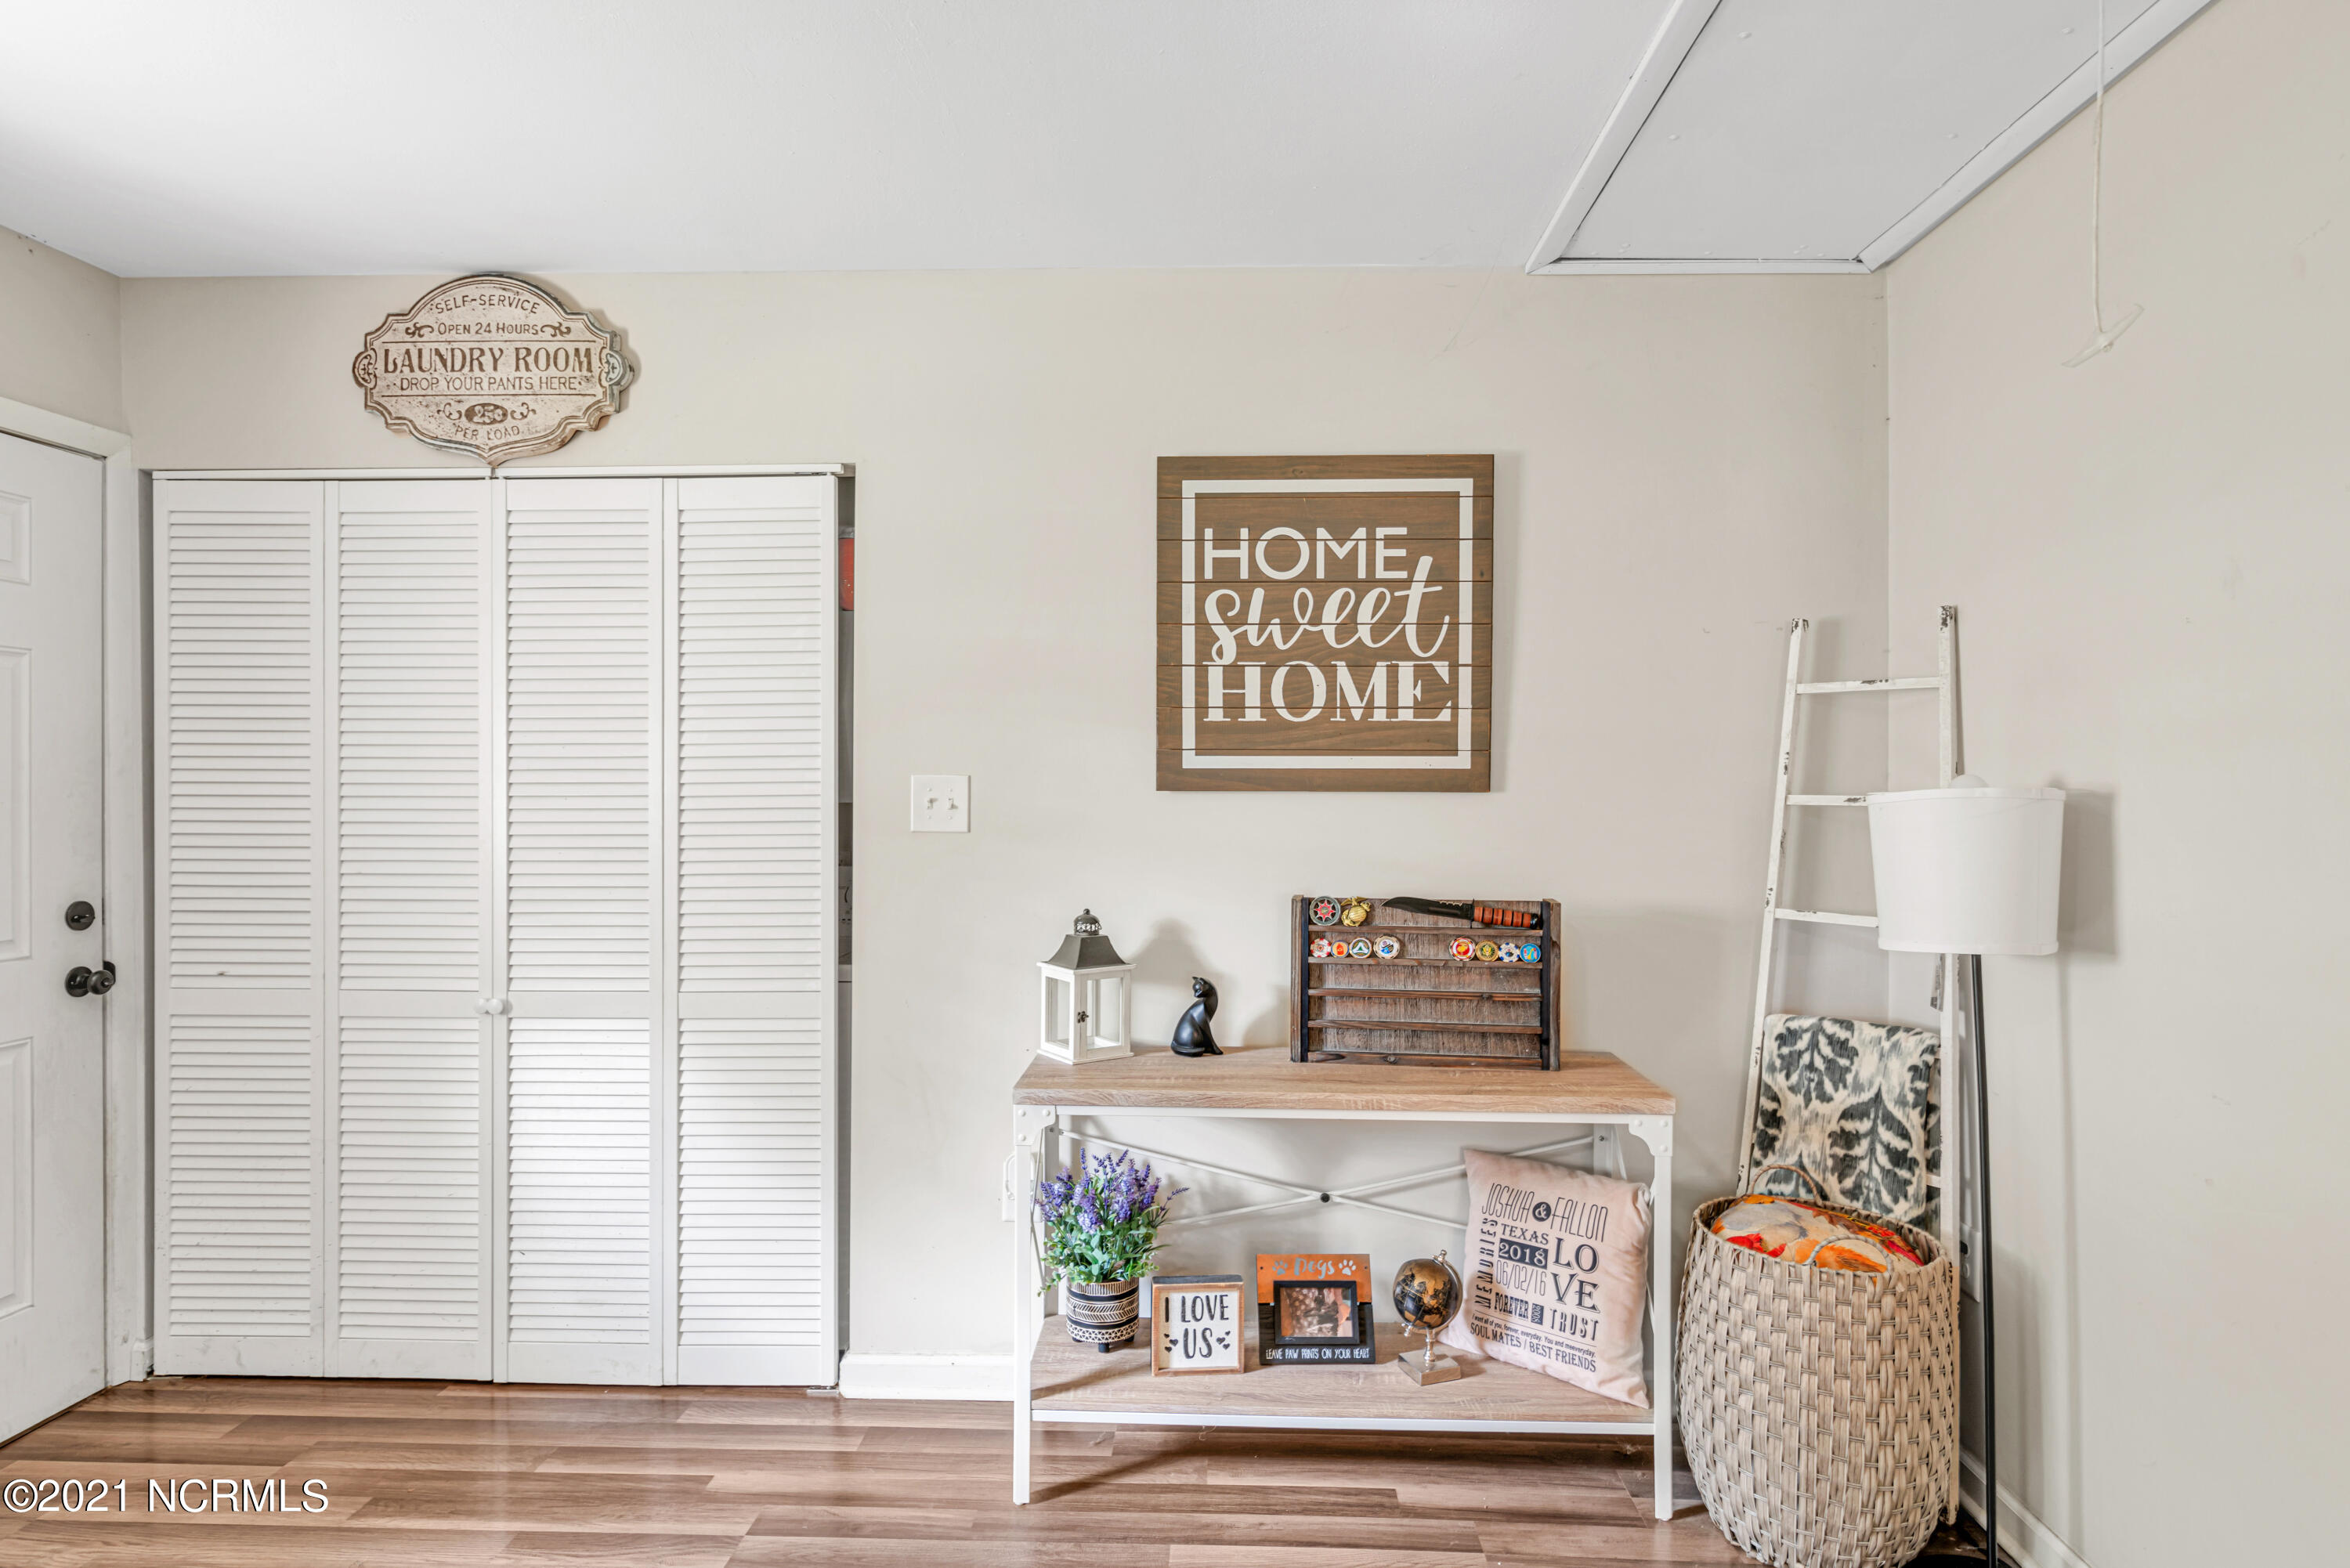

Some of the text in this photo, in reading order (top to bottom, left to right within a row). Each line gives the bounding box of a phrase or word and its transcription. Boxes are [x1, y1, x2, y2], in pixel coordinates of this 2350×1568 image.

[435, 294, 540, 314] SELF-SERVICE
[437, 322, 539, 335] OPEN 24 HOURS
[384, 347, 593, 374] LAUNDRY ROOM
[400, 377, 577, 391] DROP YOUR PANTS HERE
[455, 425, 520, 440] PER LOAD
[1204, 526, 1408, 580] HOME
[1204, 555, 1450, 665] sweet
[1202, 660, 1452, 722] HOME
[1482, 1183, 1608, 1242] JOSHUA & FALLON
[1501, 1223, 1549, 1245] TEXAS
[1294, 1257, 1335, 1279] Dogs
[1474, 1218, 1498, 1310] MEMORIES
[1496, 1259, 1546, 1296] 06/02/16
[1164, 1295, 1229, 1323] I LOVE
[1495, 1292, 1529, 1320] FOREVER
[1549, 1308, 1600, 1341] TRUST
[1183, 1328, 1213, 1359] US
[1470, 1322, 1490, 1339] SOUL
[1491, 1329, 1521, 1347] MATES
[1529, 1341, 1553, 1360] BEST
[1556, 1348, 1596, 1373] FRIENDS
[1544, 1335, 1553, 1344] You
[1266, 1348, 1282, 1360] LEAVE
[1285, 1348, 1299, 1360] PAW
[1321, 1348, 1332, 1360] ON
[1334, 1348, 1350, 1359] YOUR
[1354, 1348, 1370, 1359] HEART
